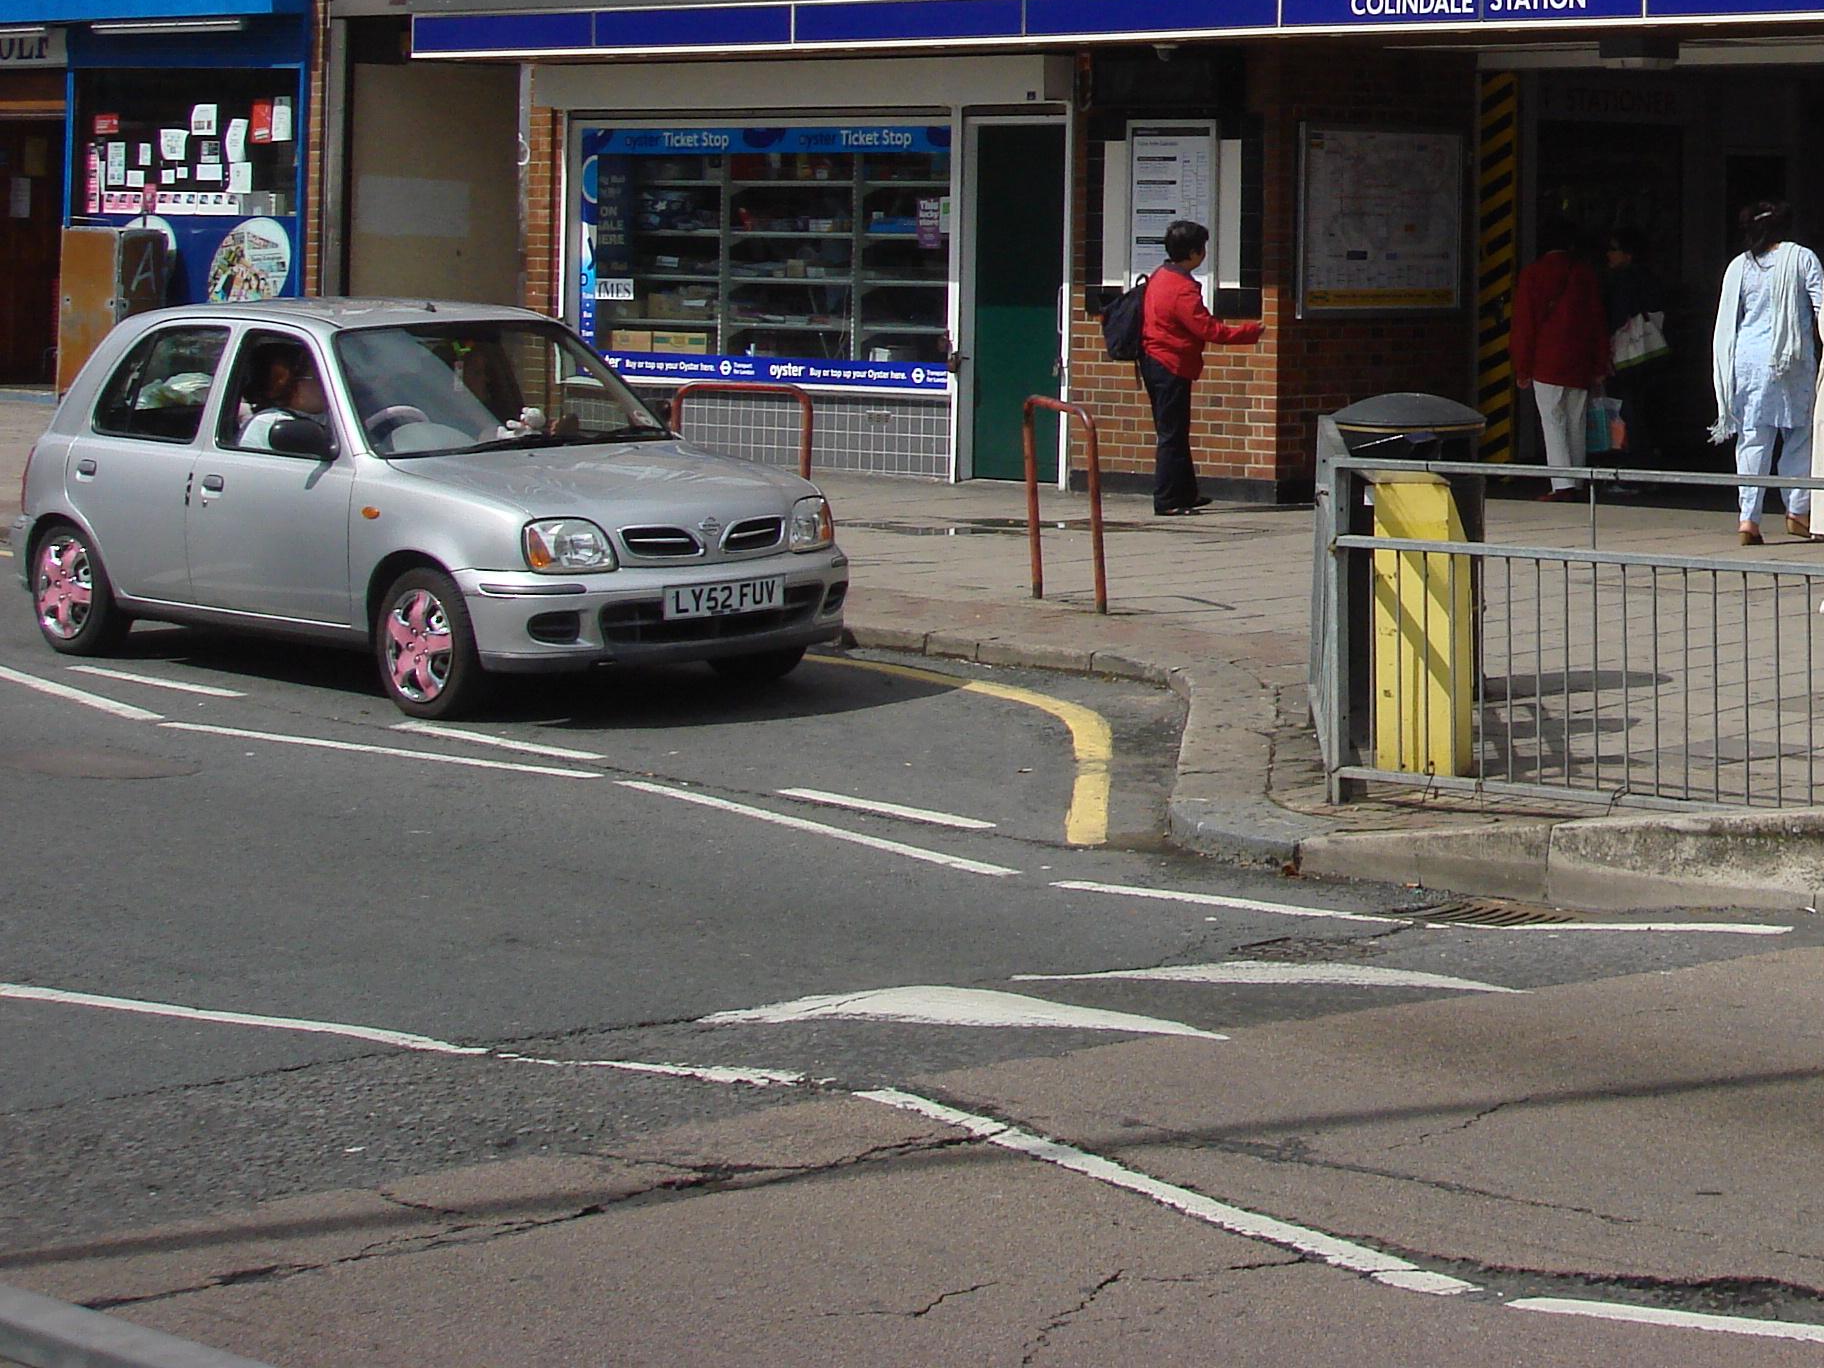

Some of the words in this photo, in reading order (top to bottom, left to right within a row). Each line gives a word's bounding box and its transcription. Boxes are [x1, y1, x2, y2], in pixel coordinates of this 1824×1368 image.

[663, 132, 699, 147] Ticket
[701, 131, 730, 150] Stop
[839, 130, 879, 146] Ticket
[882, 129, 912, 149] Stop
[625, 359, 636, 370] Buy
[644, 360, 656, 371] top
[656, 362, 665, 372] up
[665, 362, 678, 372] your
[679, 361, 700, 372] Oyster
[769, 362, 806, 380] oyster
[809, 367, 822, 378] Buy
[823, 369, 830, 377] or
[831, 368, 842, 379] top
[843, 370, 851, 380] up
[852, 370, 867, 380] your
[867, 369, 889, 381] Oyster
[675, 585, 733, 614] LY52
[739, 580, 776, 607] FUV
